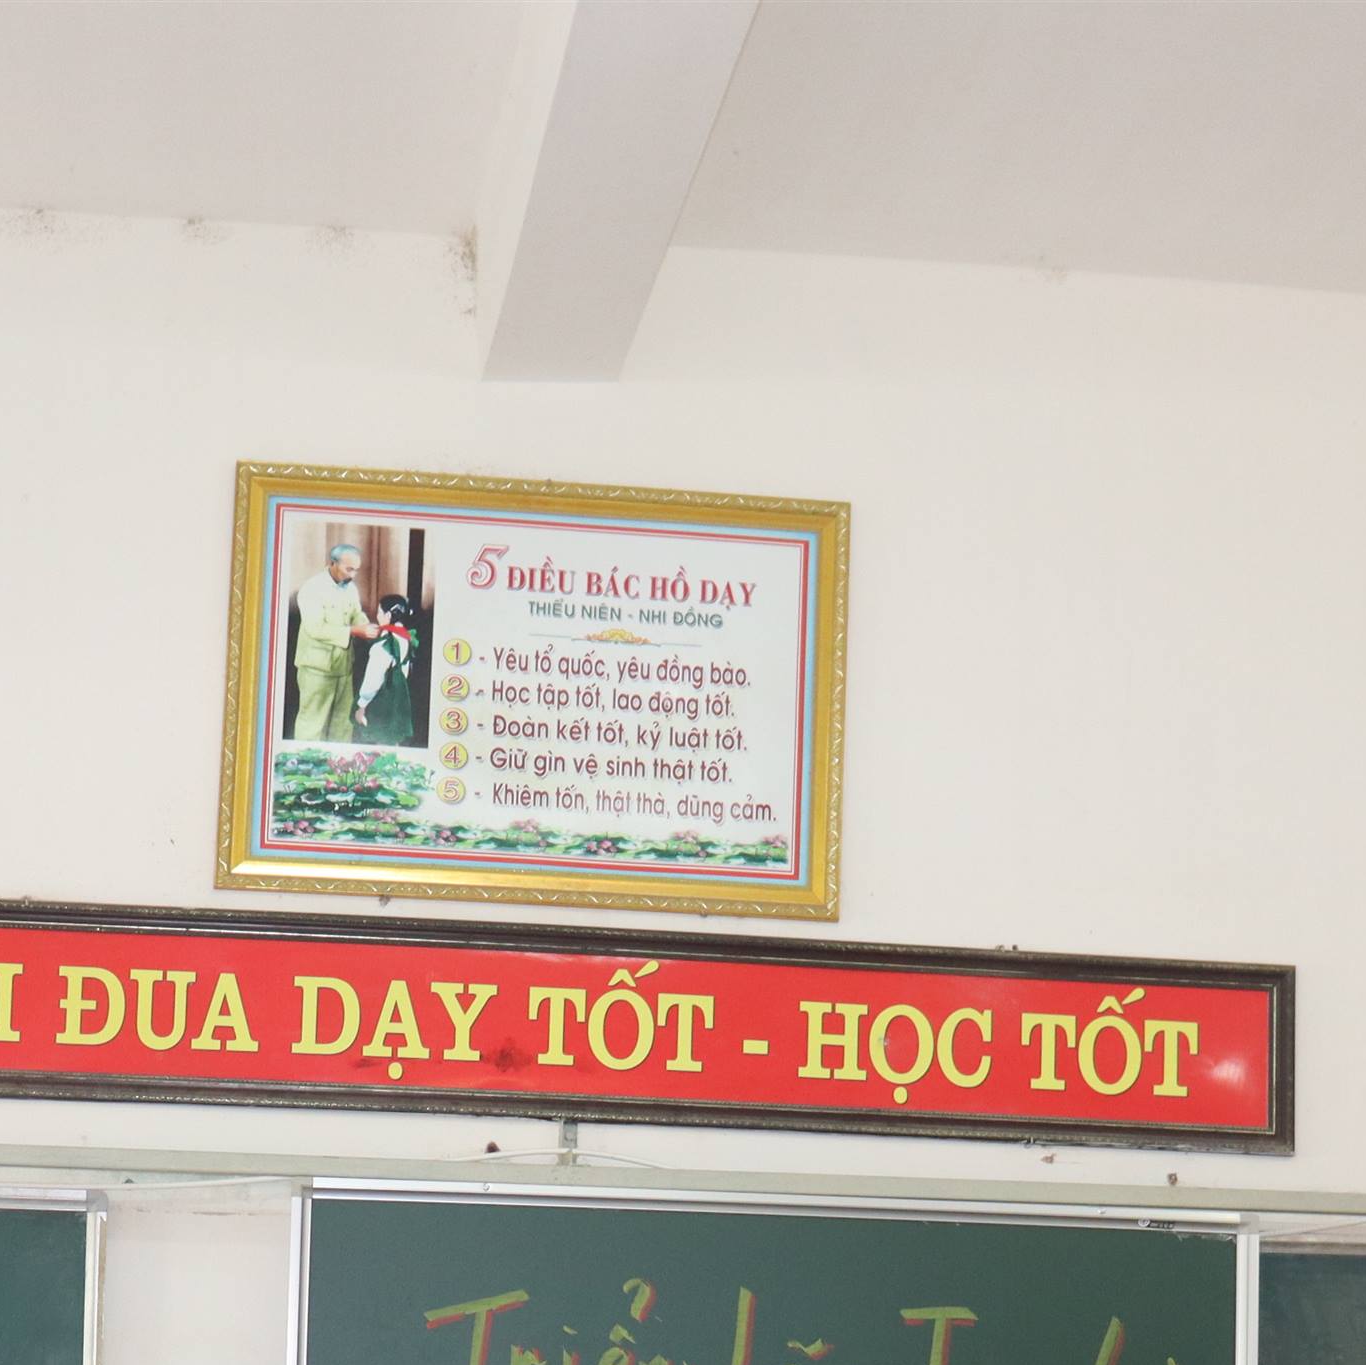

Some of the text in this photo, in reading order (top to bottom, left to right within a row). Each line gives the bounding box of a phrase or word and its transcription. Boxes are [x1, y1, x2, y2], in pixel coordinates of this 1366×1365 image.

[467, 544, 756, 610] 5 ĐIỀU BÁC HỒ DẠY
[581, 603, 622, 622] NIÊN
[639, 606, 666, 625] NHI
[673, 607, 723, 629] ĐỒNG
[493, 646, 529, 671] Yêu
[535, 644, 554, 673] tổ
[558, 650, 610, 680] quốc,
[617, 657, 650, 683] yêu
[656, 654, 704, 689] đồng
[710, 661, 751, 687] bào.
[491, 680, 531, 708] Học
[537, 683, 570, 710] tập
[575, 682, 605, 712] tốt,
[612, 688, 642, 712] lao
[648, 691, 699, 720] động
[705, 691, 735, 717] tốt.
[493, 715, 549, 738] Đoàn
[556, 717, 590, 741] kết
[596, 719, 629, 747] tốt,
[637, 721, 661, 750] kỷ
[669, 726, 709, 752] luật
[715, 726, 747, 751] tốt.
[490, 747, 528, 770] Giữ
[534, 750, 565, 777] gìn
[573, 753, 598, 779] vệ
[606, 755, 646, 778] sinh
[653, 758, 693, 784] thật
[700, 758, 732, 782] tốt.
[492, 783, 550, 808] Khiêm
[555, 784, 589, 813] tốn,
[596, 789, 631, 818] thật
[636, 791, 670, 819] thà,
[677, 794, 723, 823] dũng
[730, 794, 777, 822] cảm.
[54, 965, 260, 1053] ĐUA
[290, 974, 499, 1081] DẠY
[527, 960, 715, 1072] TỐT
[798, 1000, 993, 1105] HỌC
[1019, 987, 1199, 1098] TỐT
